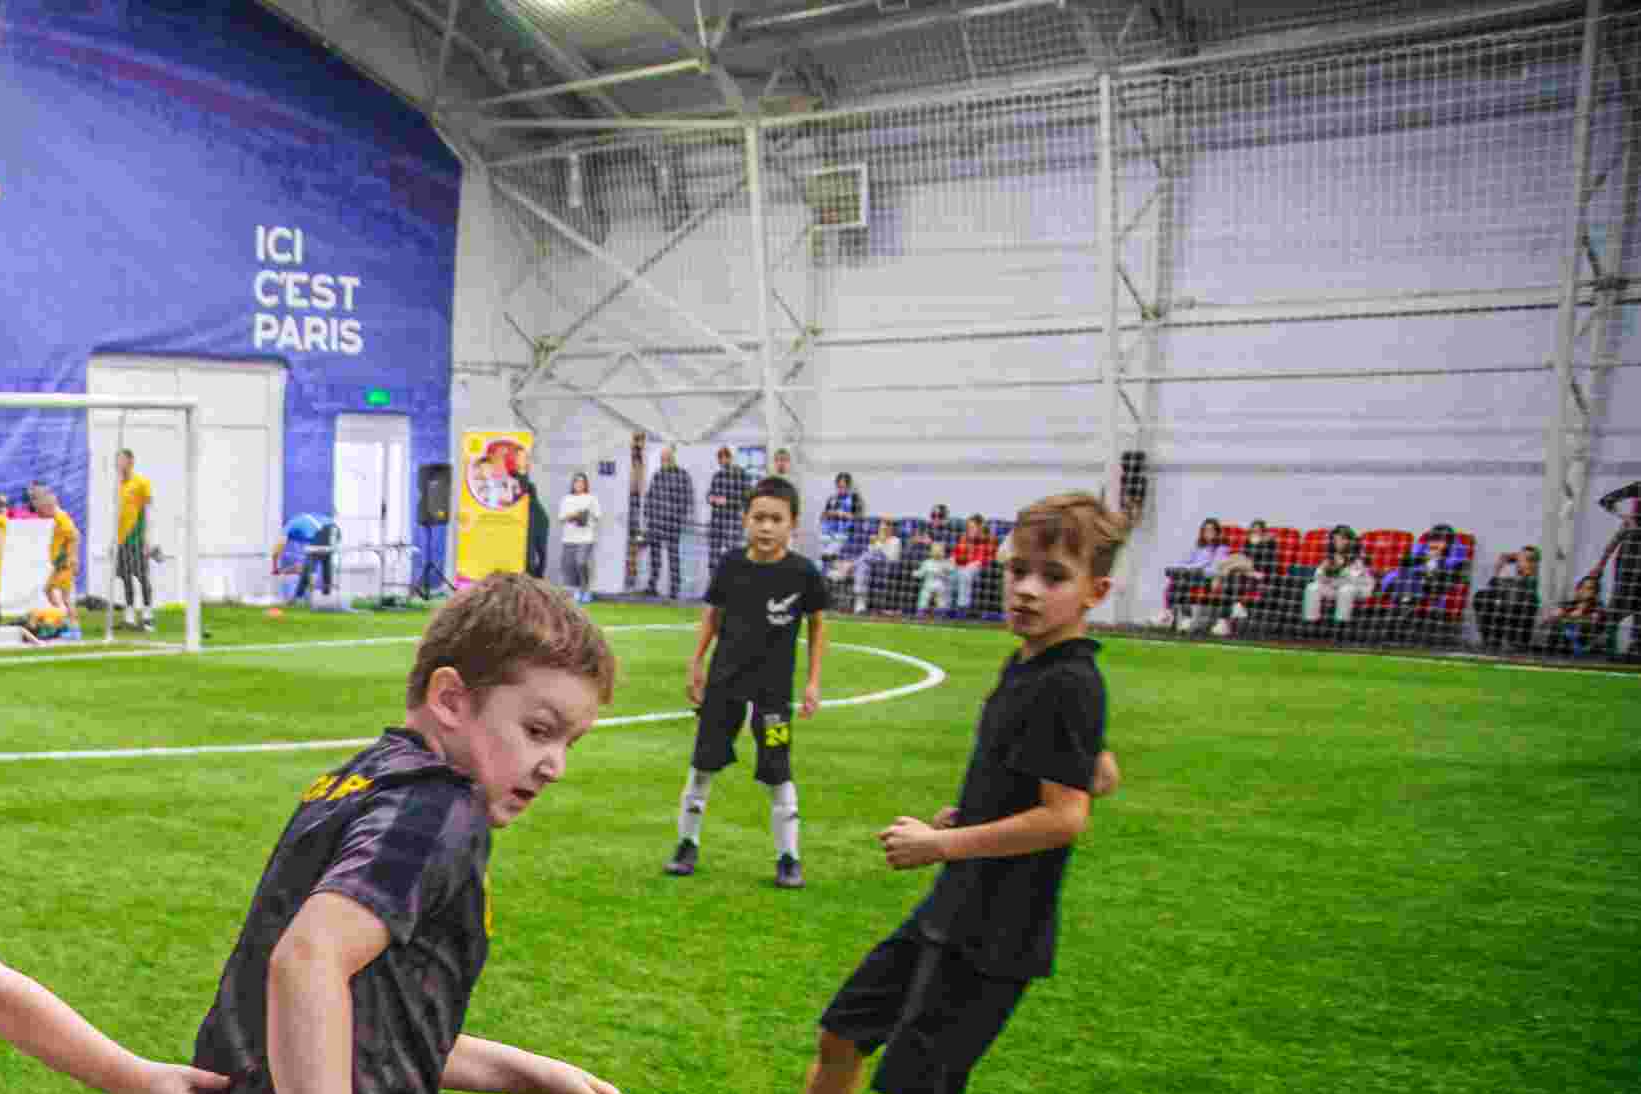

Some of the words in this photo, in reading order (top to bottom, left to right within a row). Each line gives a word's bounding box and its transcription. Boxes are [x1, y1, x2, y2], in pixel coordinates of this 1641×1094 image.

[255, 225, 304, 264] ICI
[254, 269, 361, 311] C'EST
[254, 313, 363, 353] PARIS
